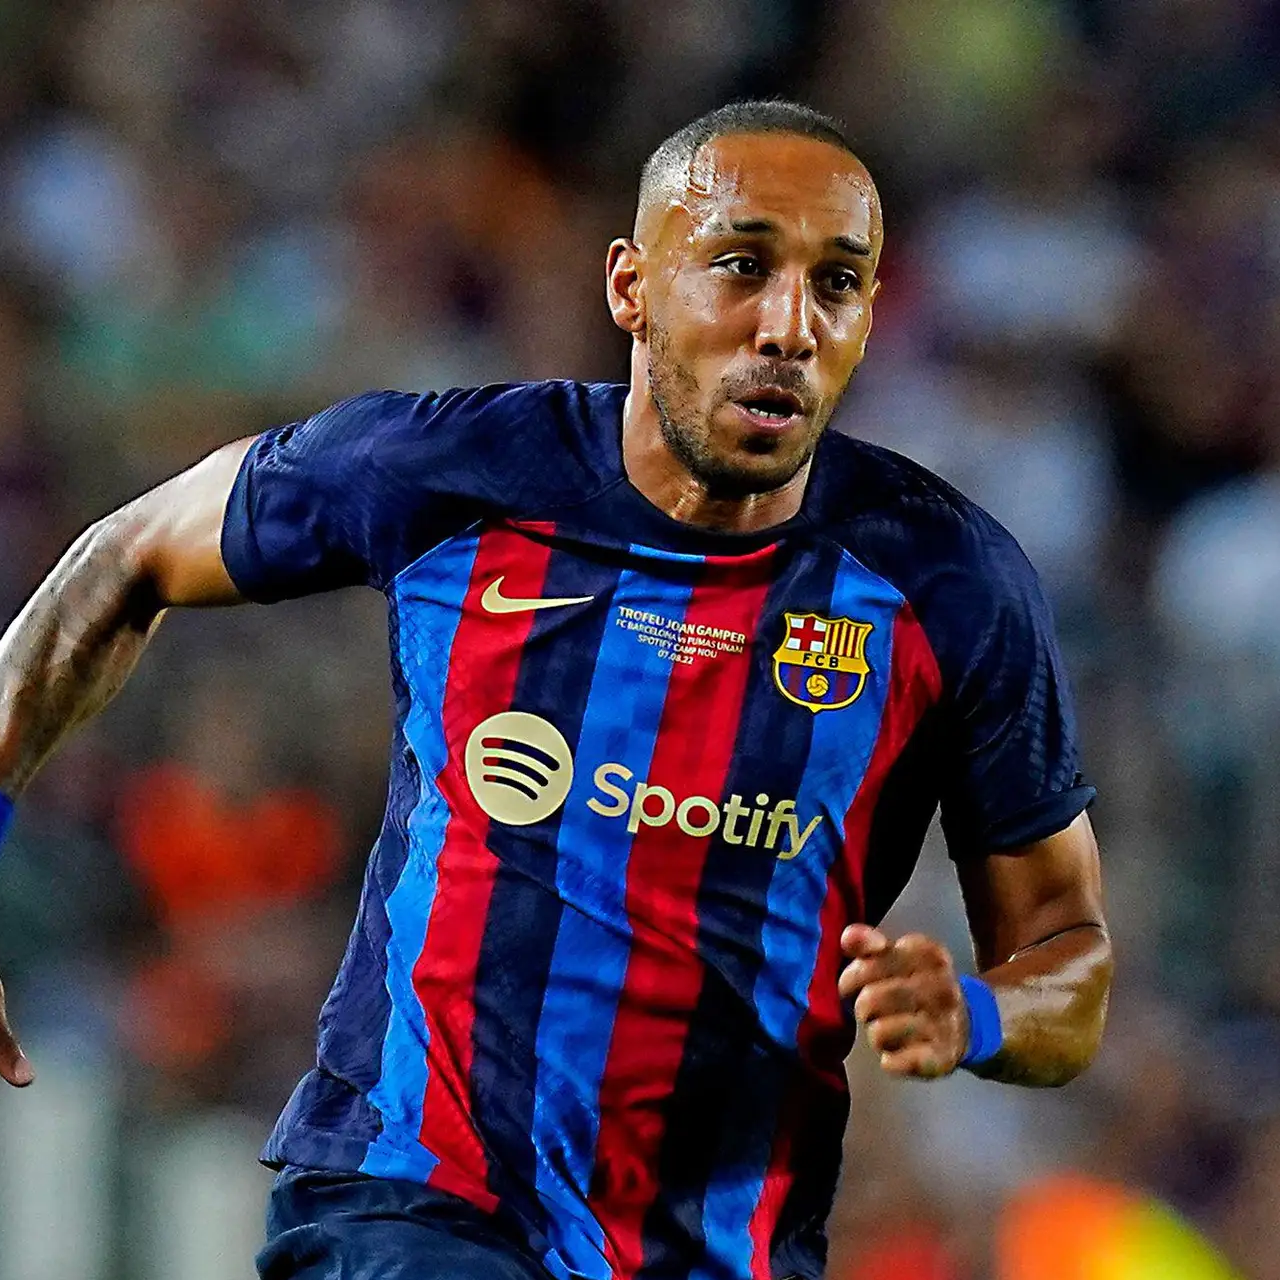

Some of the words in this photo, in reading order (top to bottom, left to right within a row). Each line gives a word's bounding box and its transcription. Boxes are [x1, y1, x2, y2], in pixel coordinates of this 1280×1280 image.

[616, 618, 627, 628] FC
[627, 621, 677, 641] BARCELONA
[618, 606, 664, 626] TROFEU
[665, 619, 695, 634] JOAN
[696, 624, 745, 644] GAMPER
[637, 634, 674, 650] SPOTIFY
[697, 648, 717, 658] NOU
[802, 653, 839, 668] FCB
[586, 763, 823, 860] Spotify
